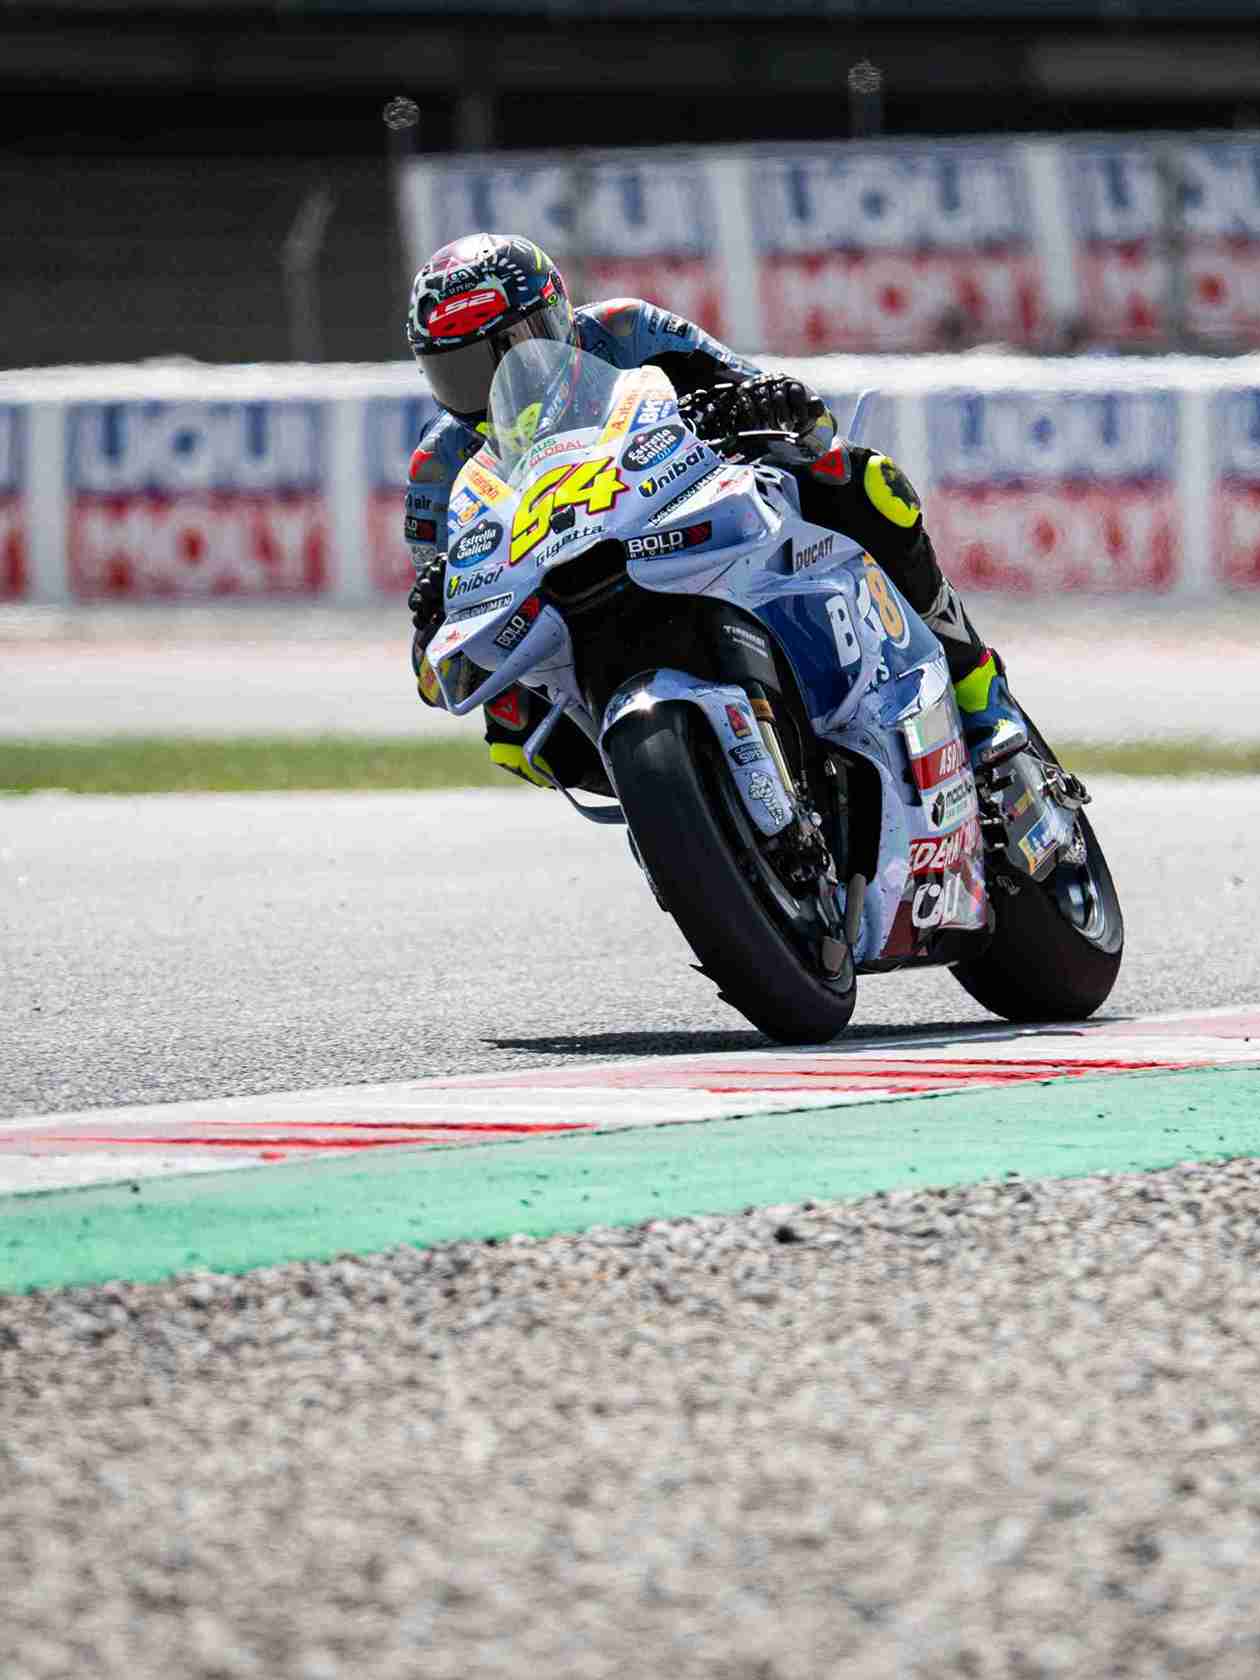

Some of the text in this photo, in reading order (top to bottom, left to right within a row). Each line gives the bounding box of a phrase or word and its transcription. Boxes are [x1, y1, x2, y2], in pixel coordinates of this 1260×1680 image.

[765, 160, 1020, 240] LIQUI
[429, 291, 497, 321] LS2
[775, 258, 1024, 343] MOLY
[80, 402, 312, 482] LIQUI
[627, 428, 671, 461] Estrella
[636, 434, 678, 465] Galicia
[938, 402, 1163, 474] LIQUI
[508, 455, 630, 567] 54
[85, 502, 312, 588] MOLY
[456, 540, 493, 560] Galicia
[458, 528, 498, 550] Estrella
[627, 530, 683, 553] BOLD
[795, 534, 834, 571] DUCATI
[945, 497, 1165, 582] MOLY
[446, 565, 504, 600] Unibat
[496, 614, 526, 648] BOLD
